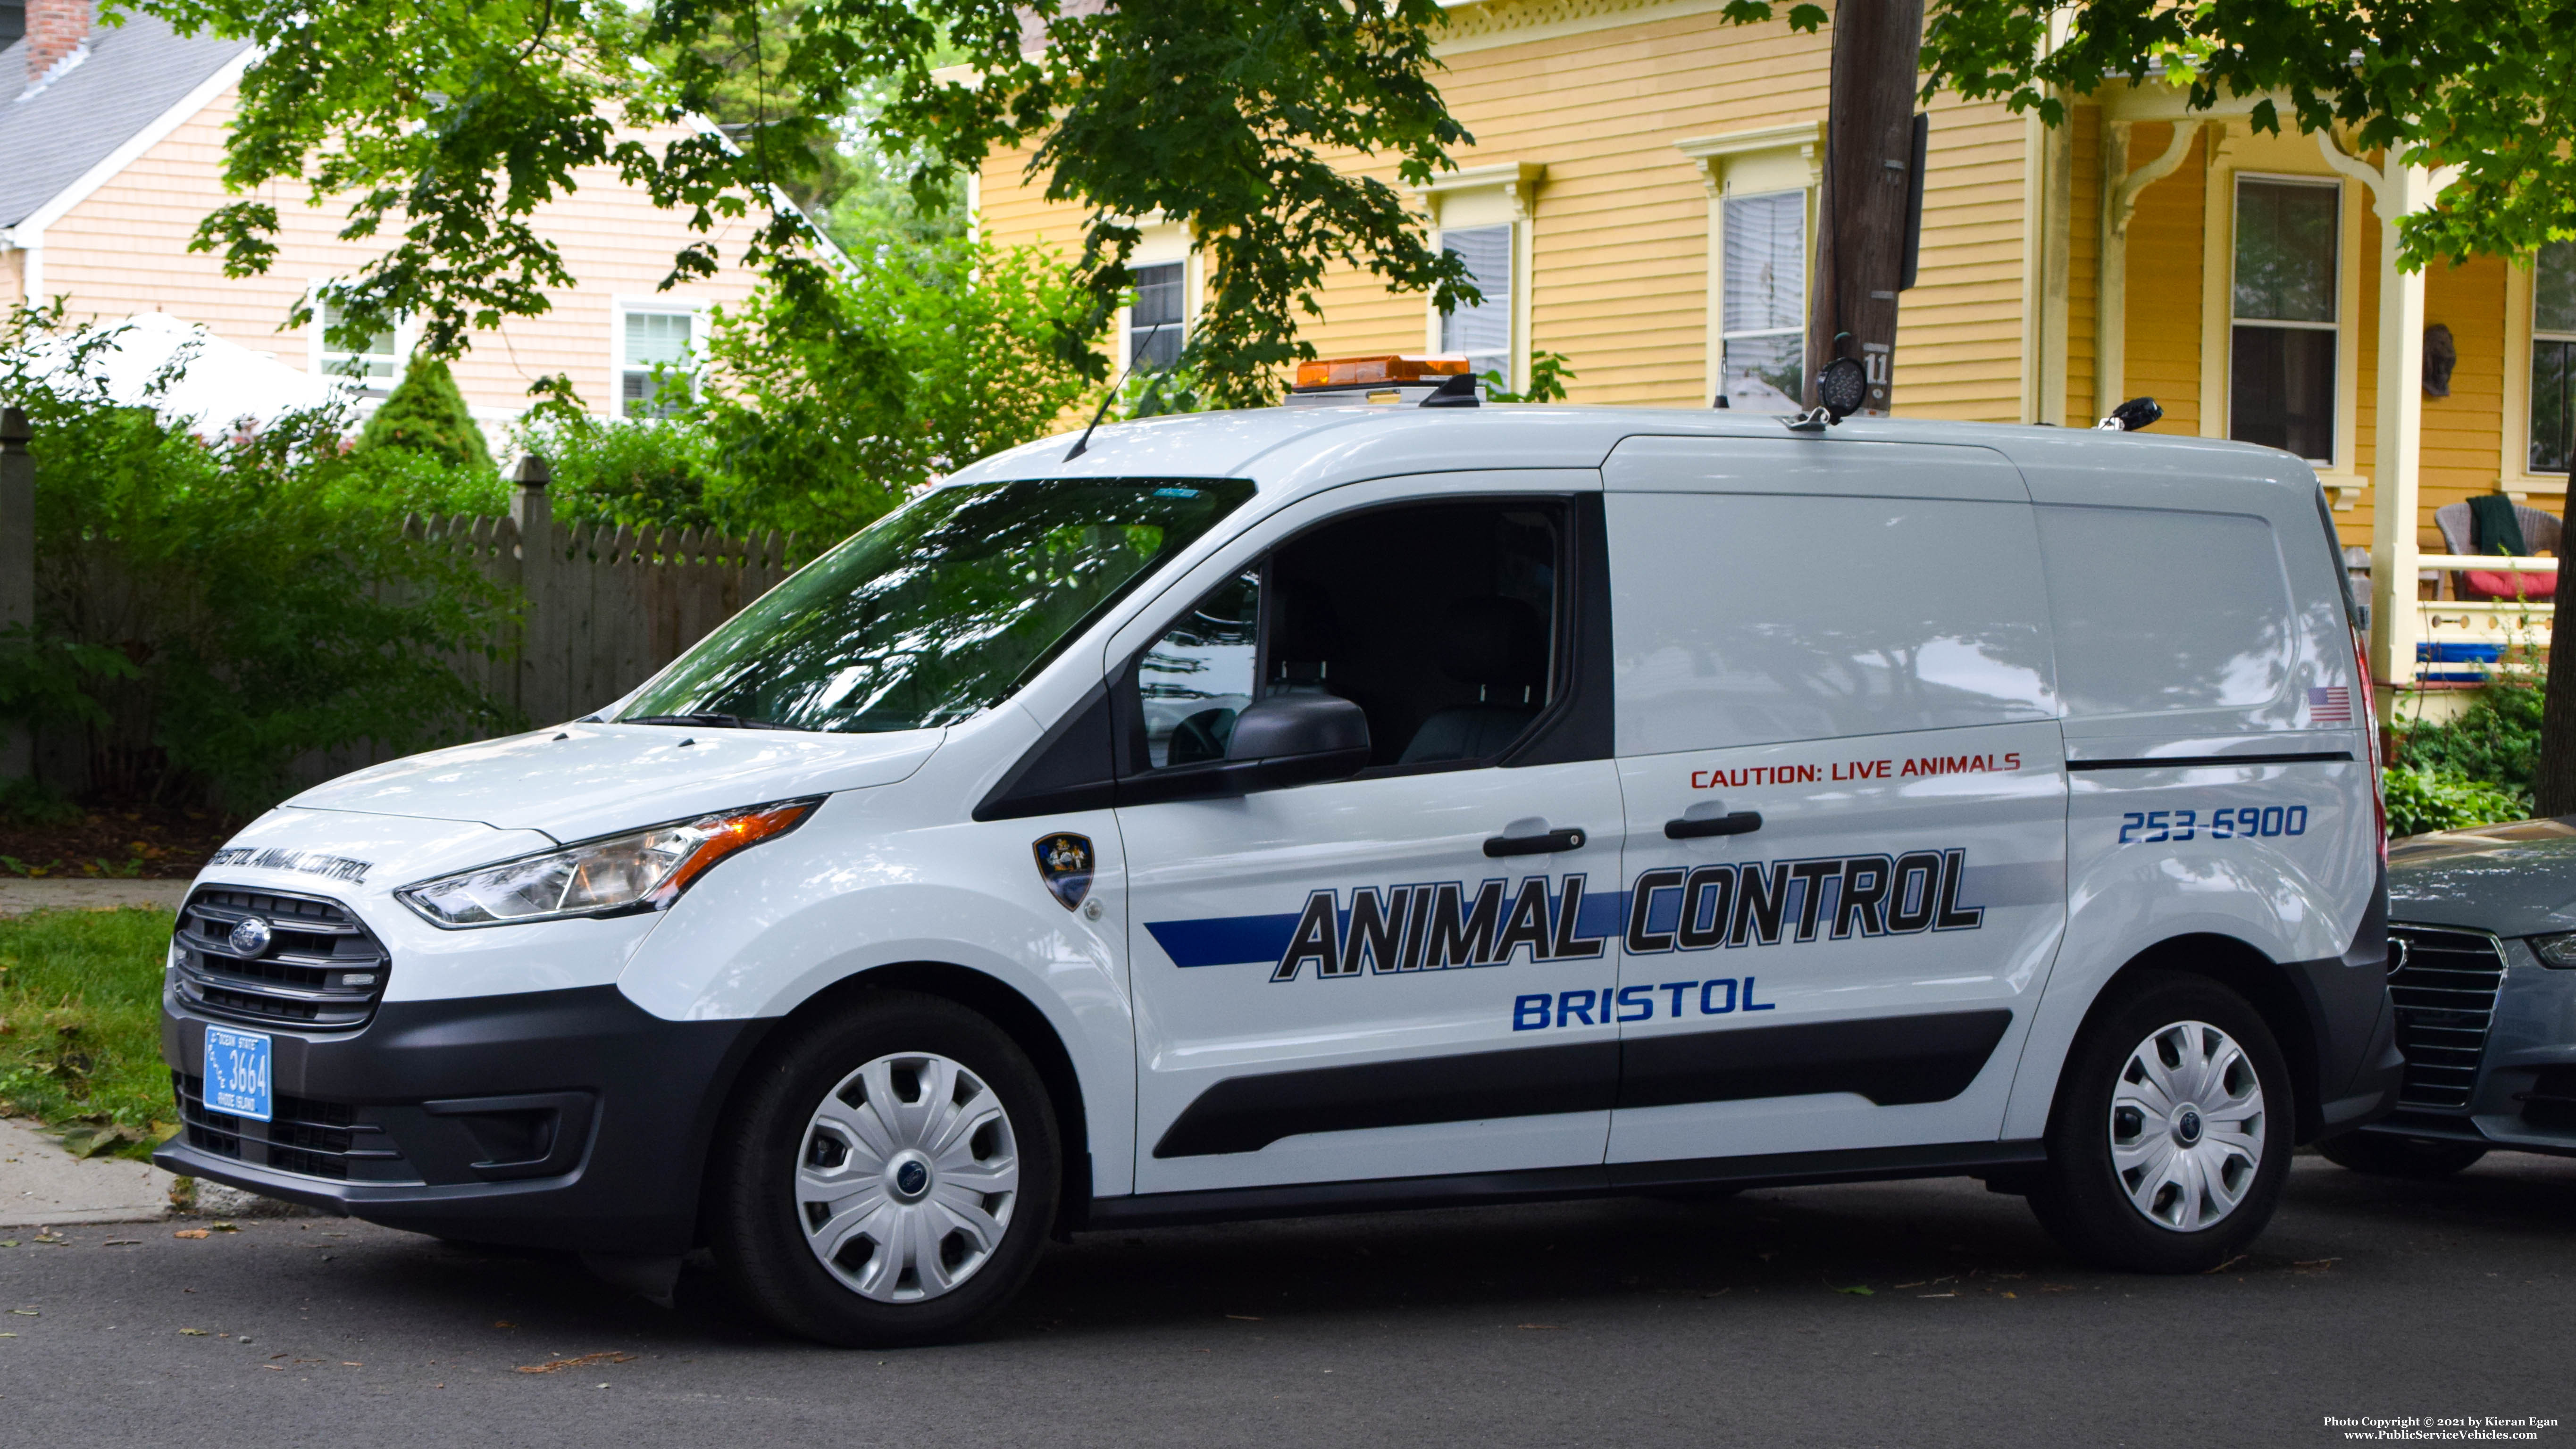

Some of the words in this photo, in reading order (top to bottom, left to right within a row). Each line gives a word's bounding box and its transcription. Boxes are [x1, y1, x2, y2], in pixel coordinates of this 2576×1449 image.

[1865, 353, 1887, 384] 11
[1691, 764, 1822, 788] CAUTION:
[1832, 760, 1891, 780] LIVE
[1900, 753, 2020, 777] ANIMALS
[2118, 805, 2308, 844] 253-6900
[247, 847, 306, 871] ANIMAL
[298, 853, 375, 887] CONTROL
[1269, 873, 1607, 983] ANIMAL
[1623, 848, 1985, 956] CONTROL
[1513, 977, 1775, 1032] BRISTOL
[229, 1049, 266, 1097] 3664
